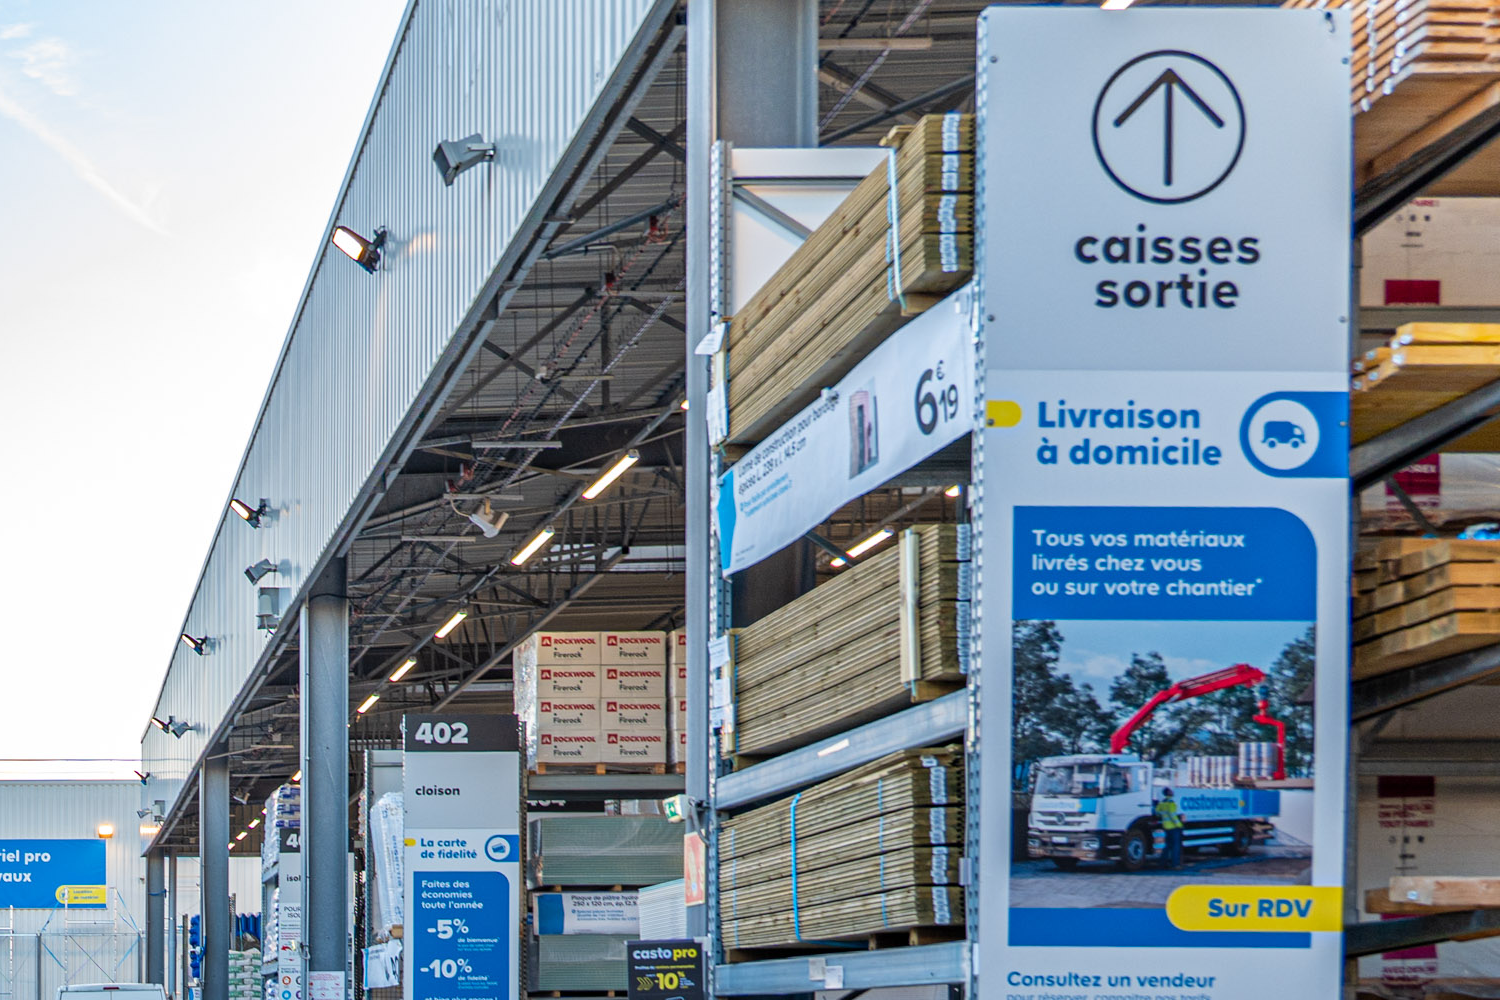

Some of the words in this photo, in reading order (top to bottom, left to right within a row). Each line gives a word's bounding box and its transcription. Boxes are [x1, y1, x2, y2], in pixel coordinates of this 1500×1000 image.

[1074, 223, 1261, 264] caisses
[1095, 268, 1239, 308] sortie
[1037, 399, 1200, 428] Livraison
[1037, 437, 1058, 465] à
[1069, 437, 1222, 466] domicile
[1032, 529, 1085, 547] Tous
[1091, 534, 1128, 547] vos
[1133, 529, 1245, 547] matériaux
[1032, 553, 1089, 572] livrés
[1095, 553, 1145, 572] chez
[1151, 558, 1202, 572] vous
[1032, 582, 1059, 596] ou
[1065, 582, 1099, 596] sur
[1104, 580, 1159, 596] votre
[415, 722, 469, 744] 402
[415, 784, 461, 796] cloison
[1180, 793, 1239, 812] castorama
[420, 838, 435, 847] La
[437, 838, 467, 847] carte
[24, 852, 51, 866] pro
[420, 849, 435, 859] de
[421, 880, 450, 889] Faites
[453, 880, 470, 889] des
[421, 890, 473, 899] économies
[421, 901, 446, 909] toute
[448, 901, 484, 909] l'année
[1209, 898, 1251, 918] Sur
[1258, 898, 1313, 918] RDV
[427, 918, 469, 940] -5%
[632, 947, 672, 959] casto
[673, 948, 697, 961] pro
[420, 958, 473, 979] -10%
[1007, 971, 1102, 988] Consultez
[1108, 976, 1131, 988] un
[1137, 973, 1217, 988] vendeur
